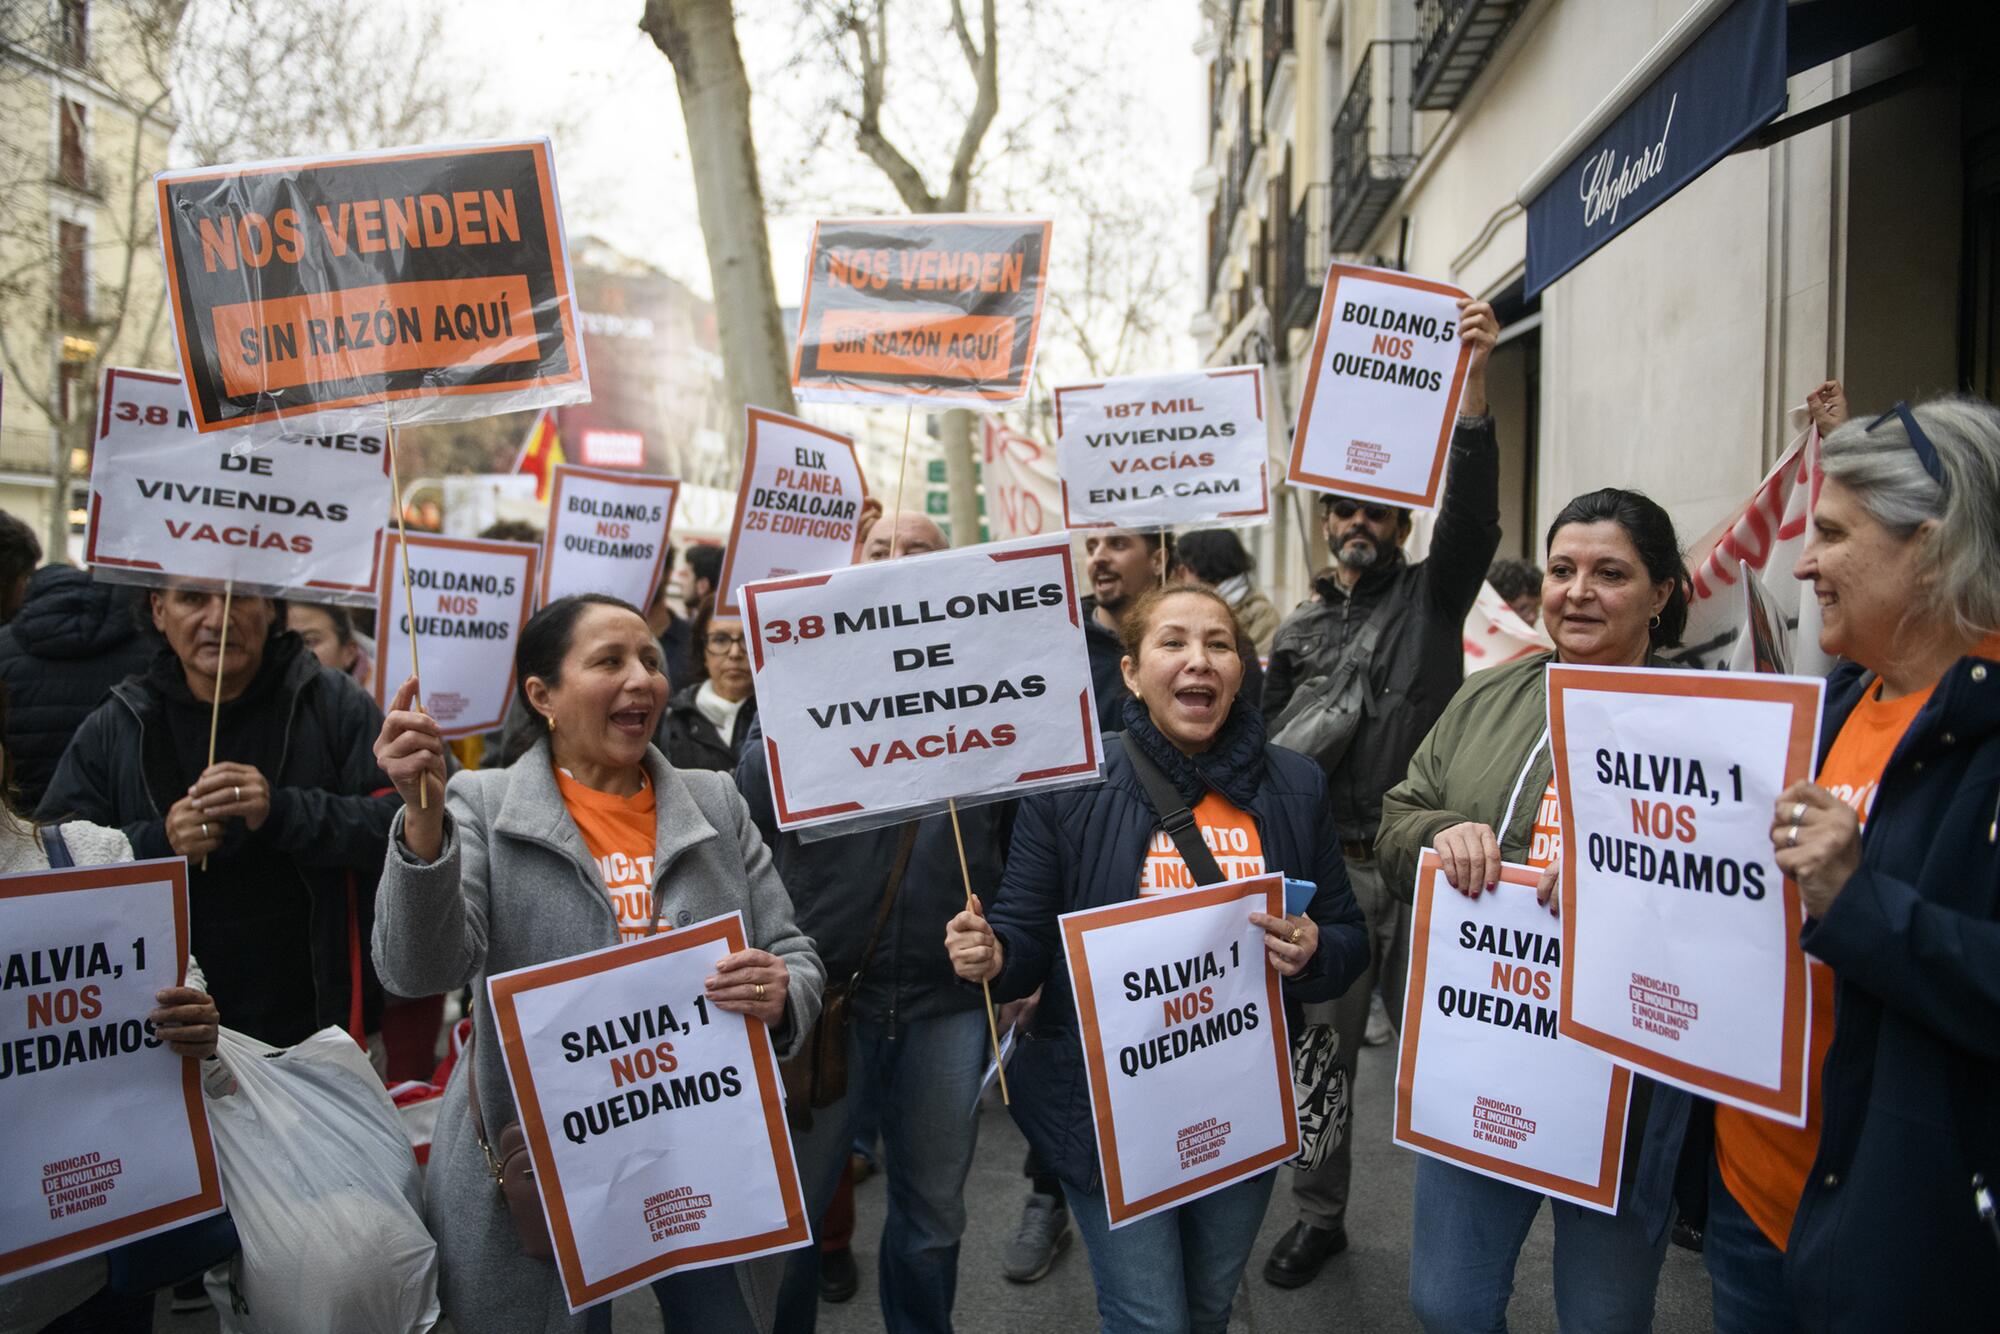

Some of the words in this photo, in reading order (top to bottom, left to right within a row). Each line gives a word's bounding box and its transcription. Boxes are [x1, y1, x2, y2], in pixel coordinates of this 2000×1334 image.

[1579, 92, 1678, 228] Chopard
[198, 208, 305, 273] NOS
[316, 188, 521, 257] VENDEN
[828, 250, 891, 289] NOS
[900, 250, 1024, 293] VENDEN
[240, 322, 298, 366] SIN
[307, 300, 422, 357] RAZÓN
[434, 291, 514, 343] AQUÍ
[833, 328, 867, 353] SIN
[871, 325, 941, 356] RAZÓN
[1372, 334, 1414, 360] NOS
[1332, 352, 1442, 392] QUEDAMOS
[115, 402, 168, 426] 3,8
[1104, 402, 1146, 419] 187
[1151, 398, 1204, 416] MIL
[1085, 422, 1236, 448] VIVIENDAS
[219, 454, 273, 476] DE
[795, 447, 827, 471] ELIX
[1110, 452, 1215, 474] VACÍAS
[775, 468, 842, 496] PLANEA
[1090, 487, 1126, 504] EN
[1132, 484, 1168, 501] LA
[1174, 479, 1240, 498] CAM
[136, 479, 349, 522] VIVIENDAS
[752, 488, 856, 520] DESALOJAR
[165, 520, 313, 554] VACÍAS
[596, 521, 630, 540] NOS
[745, 511, 768, 532] 25
[770, 513, 853, 541] EDIFICIOS
[564, 534, 654, 560] QUEDAMOS
[437, 596, 478, 615] NOS
[764, 615, 826, 645] 3,8
[834, 583, 1064, 636] MILLONES
[400, 614, 509, 640] QUEDAMOS
[893, 643, 954, 672] DE
[806, 674, 1047, 729] VIVIENDAS
[850, 723, 1017, 768] VACÍAS
[1595, 748, 1720, 806] SALVIA,
[1728, 763, 1743, 802] 1
[1631, 798, 1697, 844] NOS
[1588, 832, 1766, 901] QUEDAMOS
[132, 937, 146, 971] 1
[1123, 951, 1226, 1002] SALVIA,
[1230, 941, 1240, 968] 1
[1491, 961, 1551, 1001] NOS
[1632, 973, 1680, 997] SINDICATO
[27, 984, 103, 1030] NOS
[1163, 986, 1214, 1028] NOS
[1437, 985, 1558, 1040] QUEDAM
[1632, 1003, 1637, 1014] E
[1639, 1005, 1689, 1031] INQUILINOS
[561, 1004, 690, 1064] SALVIA,
[693, 994, 710, 1025] 1
[1119, 1002, 1259, 1078] QUEDAMOS
[1632, 1015, 1643, 1029] DE
[1645, 1020, 1680, 1041] MADRID
[609, 1042, 679, 1088] NOS
[563, 1065, 742, 1145] QUEDAMOS
[1476, 1096, 1522, 1116] SINDICATO
[1177, 1117, 1217, 1139] SINDICATO
[1474, 1119, 1479, 1128] E
[1480, 1121, 1527, 1142] INQUILINOS
[1475, 1107, 1486, 1119] DE
[1487, 1110, 1535, 1132] INQUILINAS
[1179, 1140, 1189, 1150] DE
[1190, 1123, 1230, 1146] INQUILINAS
[1180, 1152, 1185, 1161] E
[1186, 1137, 1226, 1159] INQUILINOS
[1473, 1130, 1484, 1140] DE
[1485, 1133, 1518, 1150] MADRID
[43, 1151, 101, 1176] SINDICATO
[1181, 1160, 1190, 1170] DE
[1191, 1149, 1220, 1166] MADRID
[45, 1177, 60, 1193] DE
[61, 1161, 120, 1188] INQUILINAS
[48, 1195, 55, 1207] E
[56, 1178, 115, 1205] INQUILINOS
[643, 1185, 693, 1208] SINDICATO
[50, 1206, 64, 1220] DE
[65, 1194, 107, 1216] MADRID
[646, 1208, 659, 1221] DE
[660, 1195, 711, 1216] INQUILINAS
[649, 1222, 656, 1232] E
[656, 1209, 707, 1230] INQUILINOS
[652, 1231, 664, 1243] DE
[665, 1221, 700, 1237] MADRID
